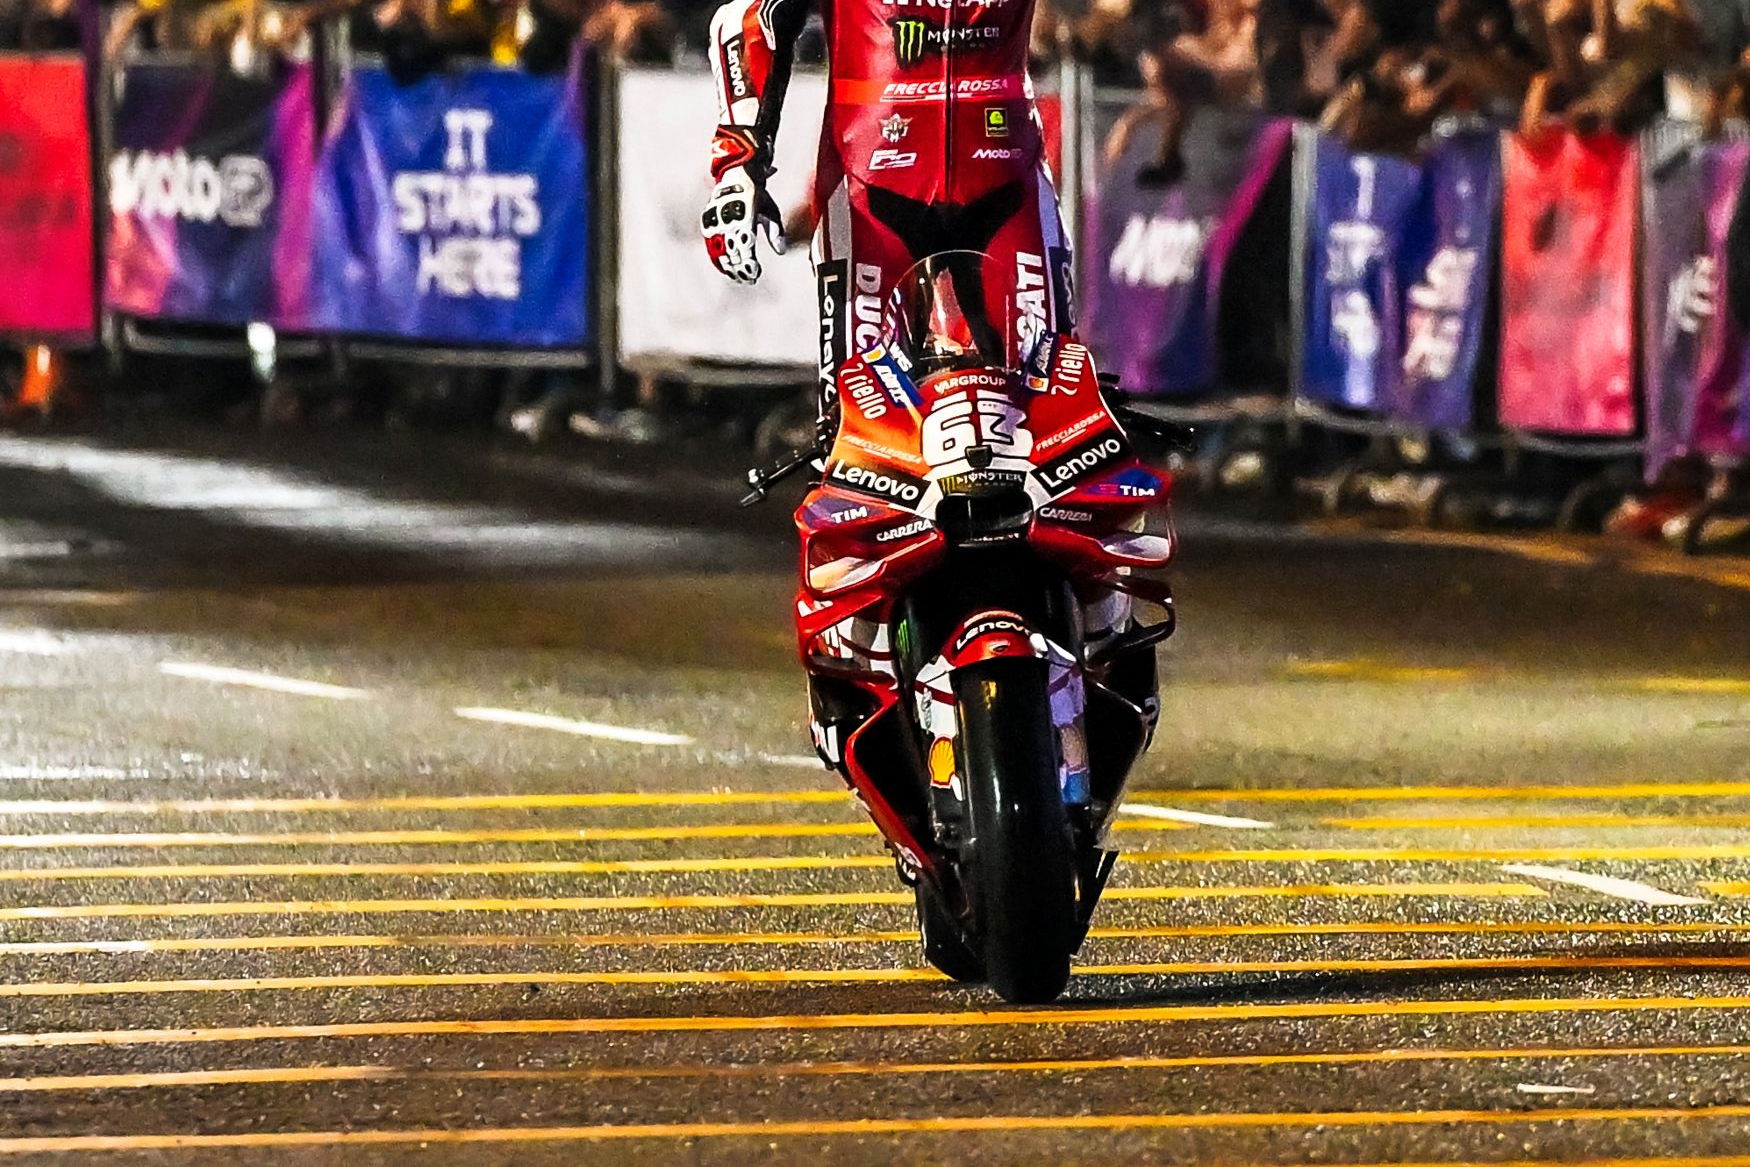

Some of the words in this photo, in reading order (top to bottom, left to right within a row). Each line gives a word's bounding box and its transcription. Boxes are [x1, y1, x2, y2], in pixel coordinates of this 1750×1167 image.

[727, 39, 746, 97] Lenovo
[444, 109, 493, 170] IT
[393, 171, 541, 235] STARTS
[1055, 343, 1086, 383] riello
[844, 373, 887, 420] riello
[922, 392, 1034, 467] 63
[832, 458, 919, 501] Lenovo
[1039, 438, 1121, 488] Lenovo
[1120, 485, 1155, 496] TIM
[831, 506, 868, 523] TIM
[876, 519, 934, 541] CARRERA
[956, 619, 1032, 650] Lenov
